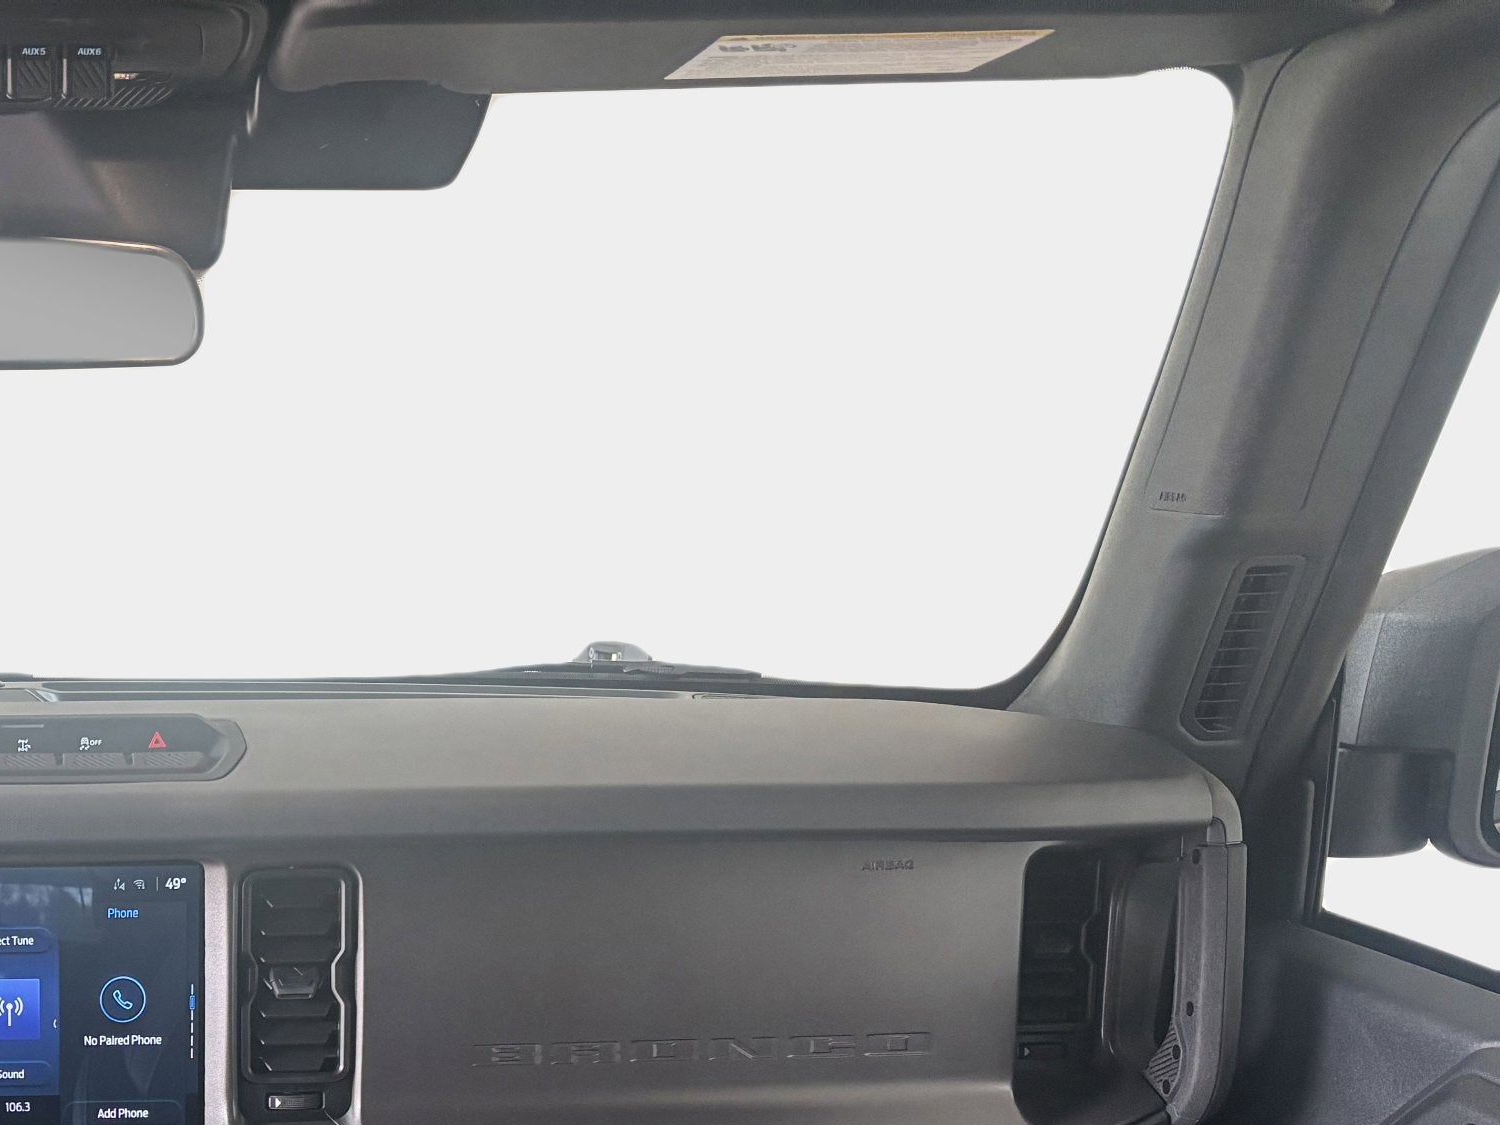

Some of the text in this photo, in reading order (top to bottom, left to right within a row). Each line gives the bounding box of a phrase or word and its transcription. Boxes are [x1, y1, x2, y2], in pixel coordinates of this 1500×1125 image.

[165, 877, 187, 889] 49°
[107, 908, 139, 919] Phone
[10, 935, 34, 946] Tune
[84, 1034, 162, 1046] No Paired Phone
[5, 1102, 31, 1113] 106.3
[97, 1107, 149, 1119] Add Phone
